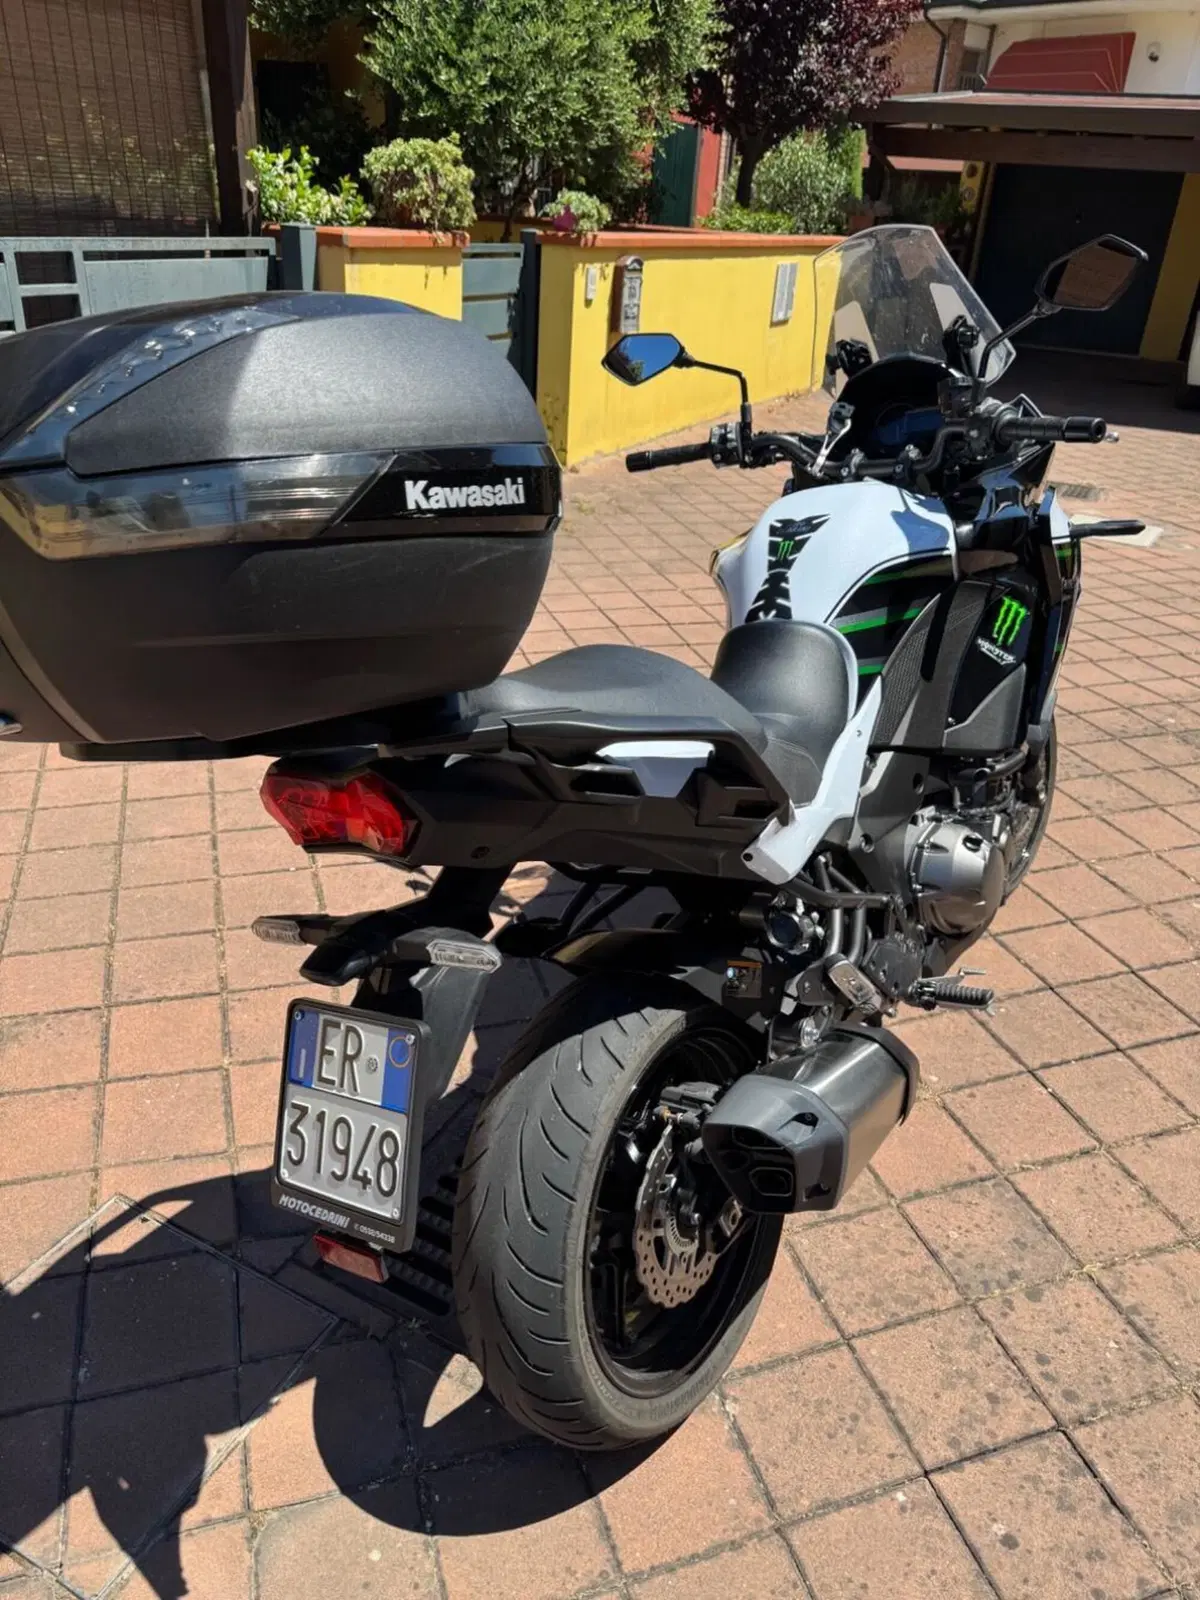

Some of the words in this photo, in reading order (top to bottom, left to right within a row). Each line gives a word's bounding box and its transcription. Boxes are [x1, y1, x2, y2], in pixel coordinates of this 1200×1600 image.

[404, 477, 525, 510] Kawasaki
[316, 1018, 364, 1095] ER
[287, 1101, 400, 1198] 31948
[279, 1193, 350, 1228] MOTOCEDRINI
